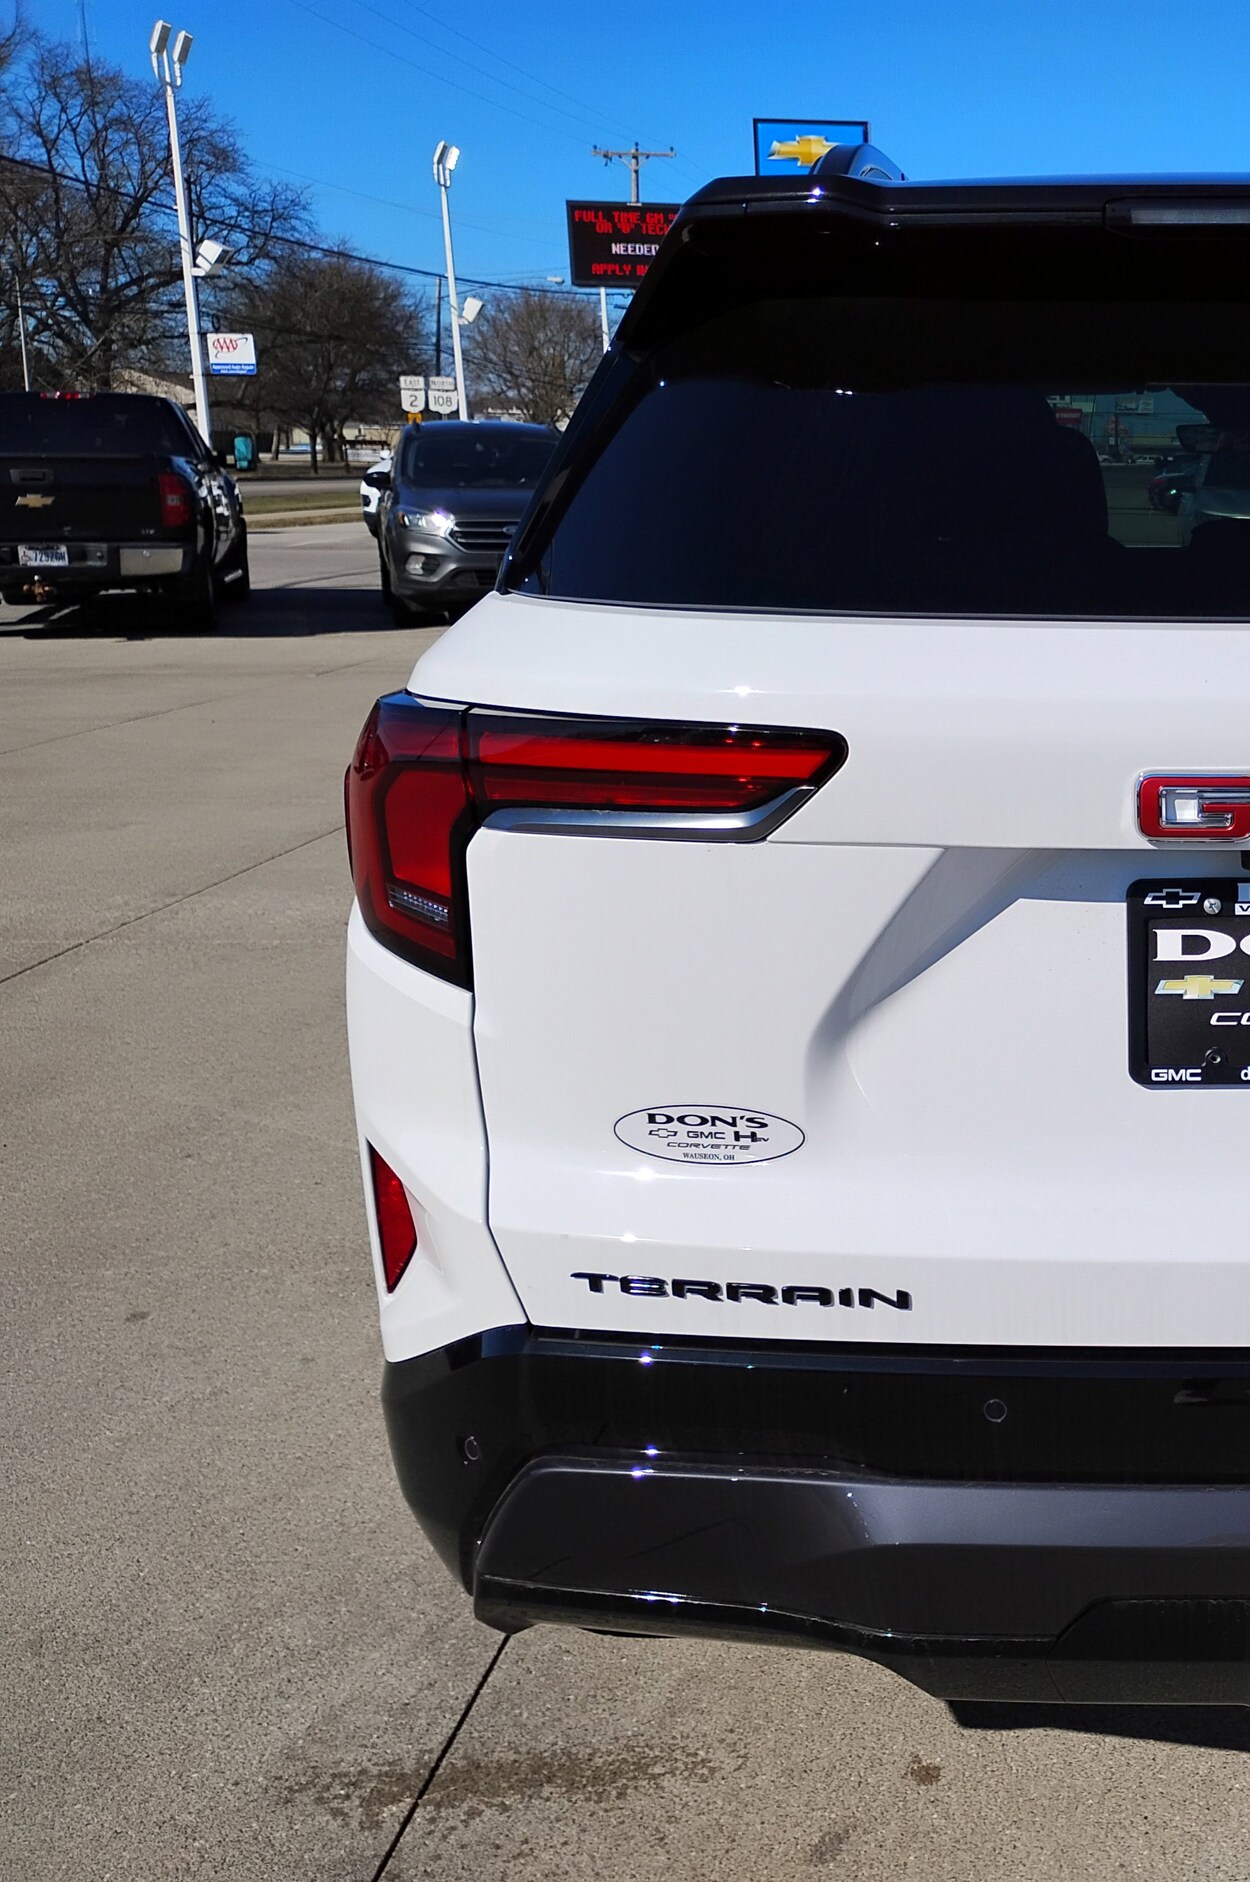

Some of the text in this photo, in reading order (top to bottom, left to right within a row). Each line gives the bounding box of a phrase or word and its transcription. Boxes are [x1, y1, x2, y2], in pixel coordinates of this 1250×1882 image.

[574, 210, 606, 223] FULL
[612, 211, 641, 223] TIME
[646, 213, 664, 224] GM
[591, 263, 632, 276] APPLY
[213, 337, 238, 352] AAA
[404, 379, 420, 387] EAST
[409, 395, 419, 408] 2
[433, 395, 453, 408] 108
[1151, 1067, 1203, 1082] GMC
[646, 1112, 769, 1129] DON'S
[686, 1130, 726, 1141] GMC
[666, 1141, 751, 1151] CORVETTE
[682, 1152, 736, 1162] WAUSEON, OH
[569, 1271, 913, 1312] TERRAIN
